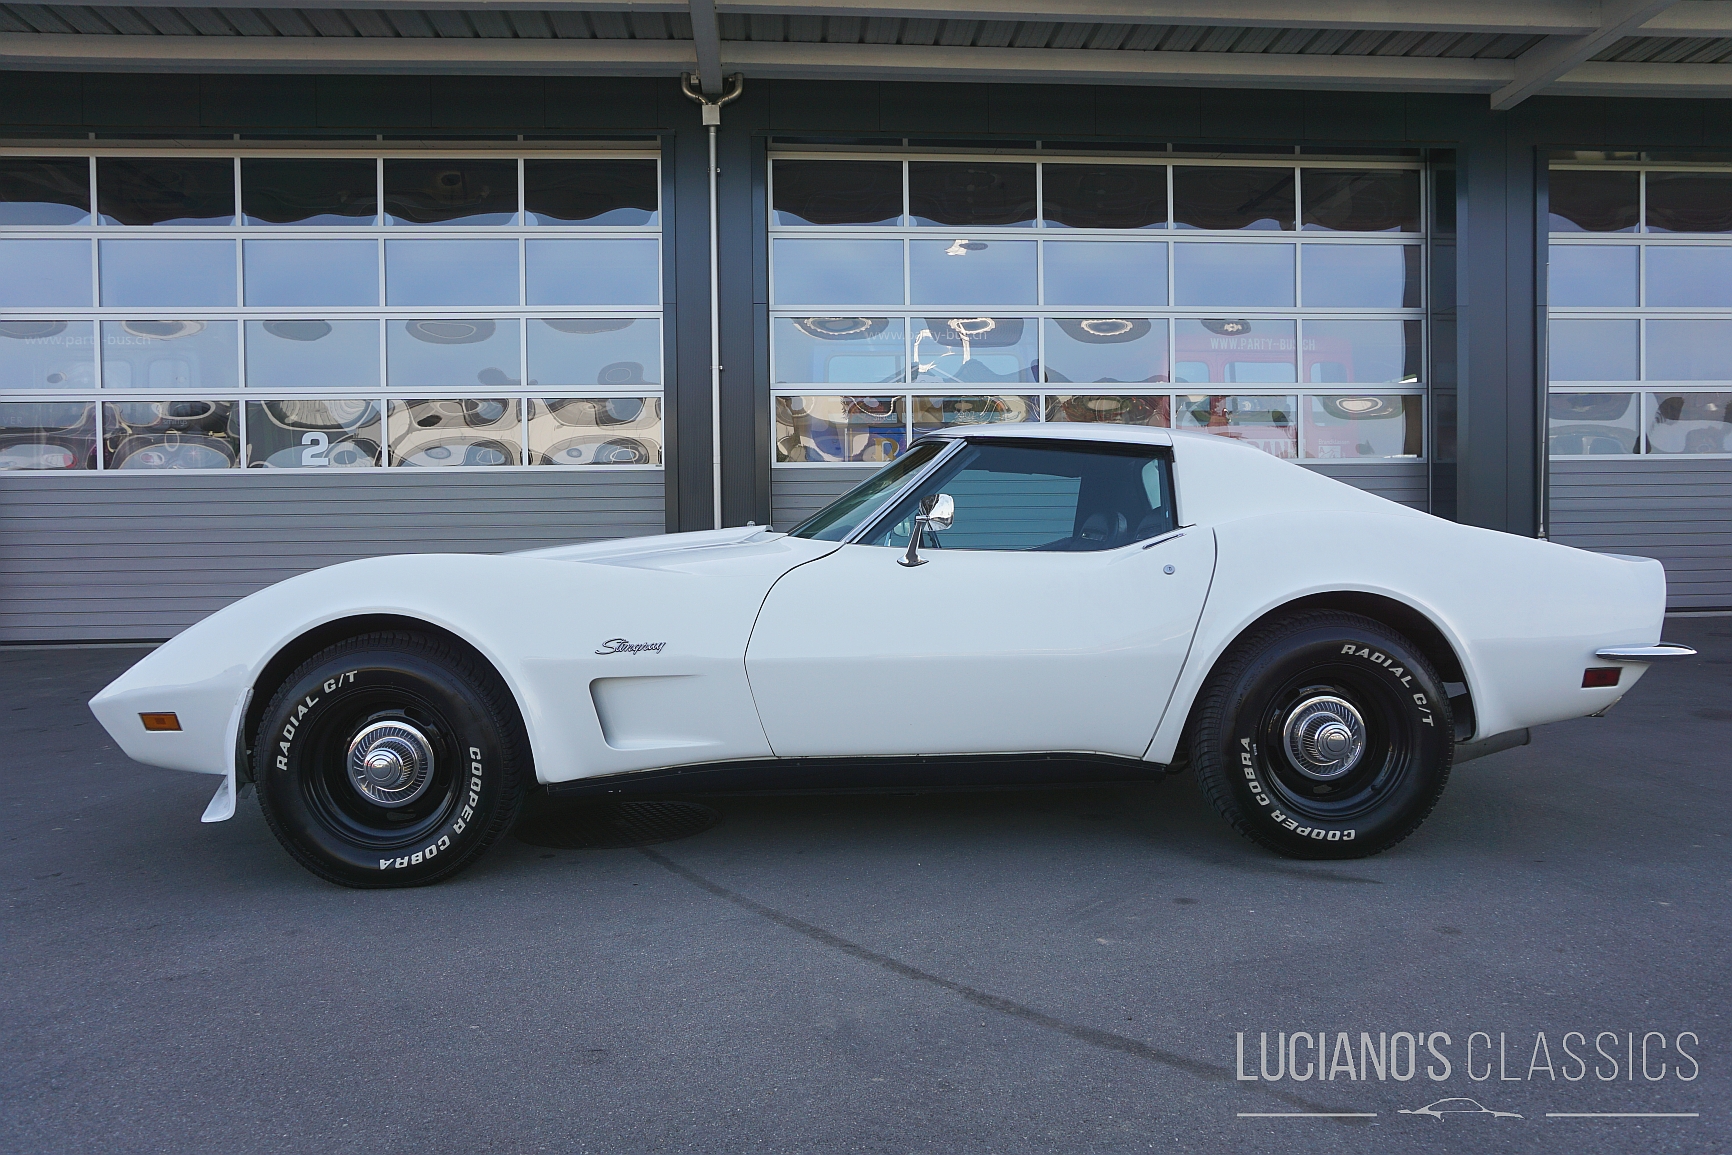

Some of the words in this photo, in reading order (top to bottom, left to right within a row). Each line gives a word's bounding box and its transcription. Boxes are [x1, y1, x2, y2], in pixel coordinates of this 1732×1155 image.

[25, 334, 151, 347] www.part-bus.ch
[302, 431, 330, 466] 2
[595, 638, 666, 655] Stingray
[1341, 644, 1411, 689] RADIAL
[1412, 693, 1434, 727] G/T
[276, 694, 319, 771] RADIAL
[323, 670, 359, 694] G/T
[1239, 737, 1271, 806] COBRA
[452, 746, 483, 835] COOPER
[1271, 809, 1356, 841] COOPER
[379, 836, 451, 871] COBRA
